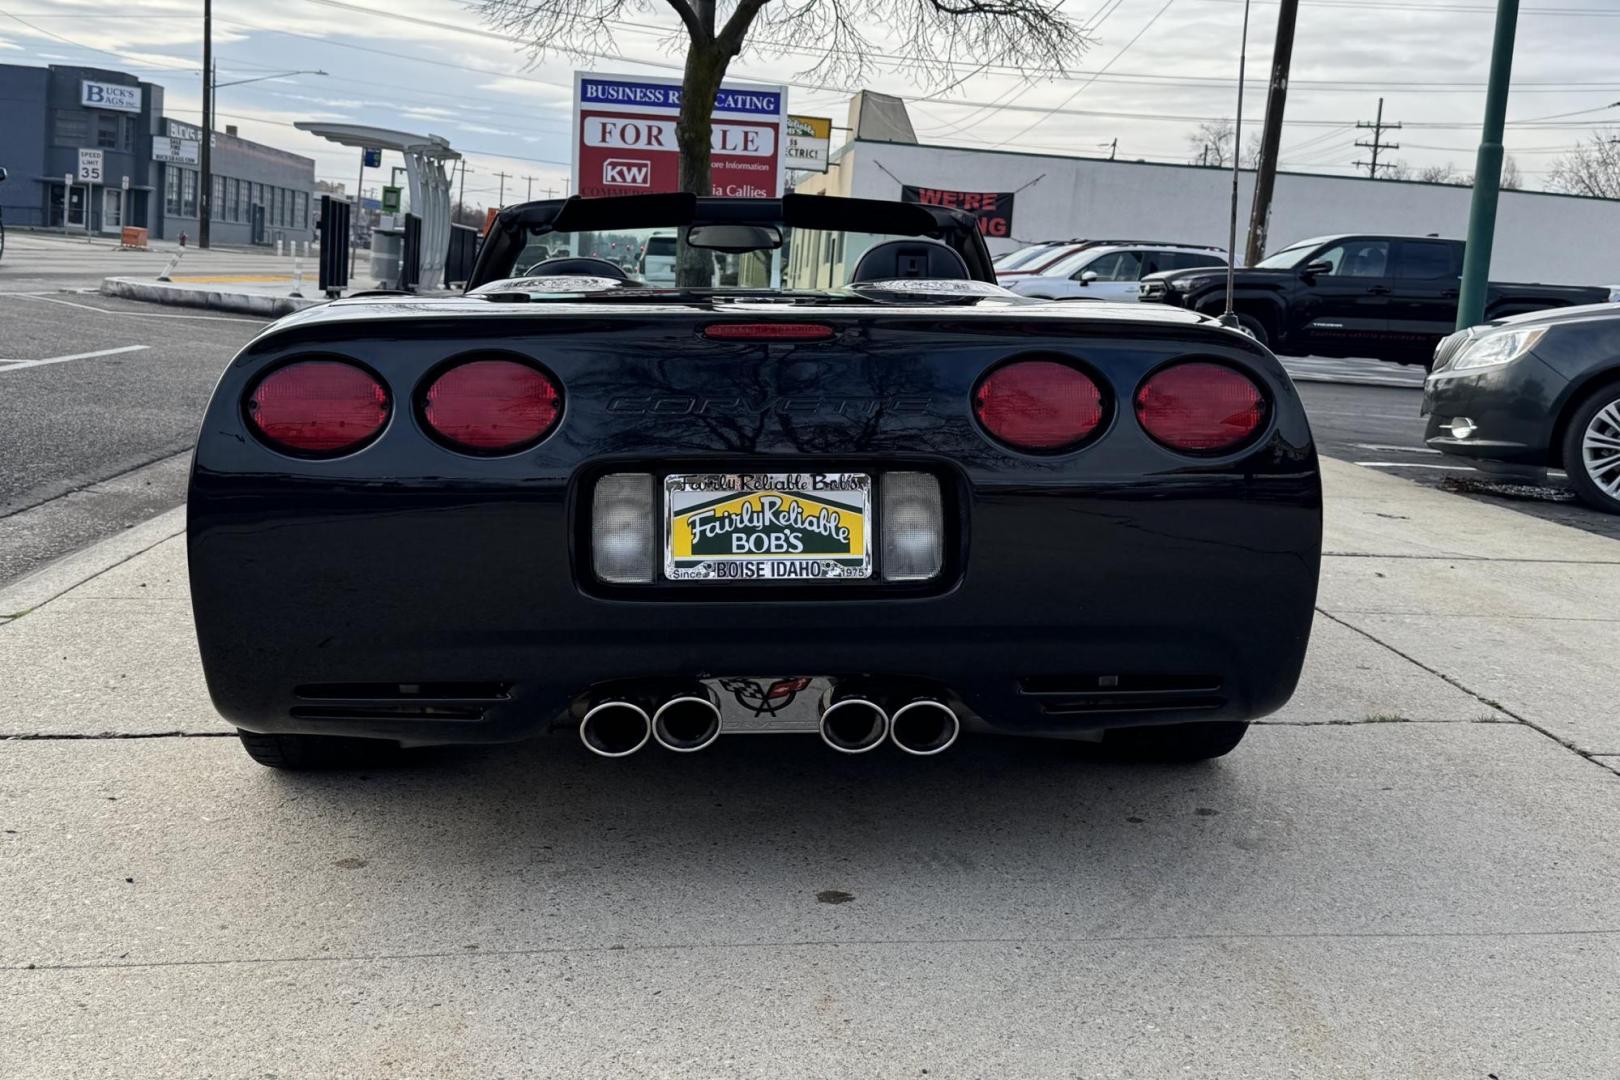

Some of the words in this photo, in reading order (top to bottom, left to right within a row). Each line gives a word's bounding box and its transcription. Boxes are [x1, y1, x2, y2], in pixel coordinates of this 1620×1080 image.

[585, 84, 664, 103] BUSINESS
[600, 121, 665, 147] FOR
[711, 128, 760, 152] LE
[81, 167, 100, 179] 35
[606, 165, 648, 184] KW
[726, 162, 769, 171] Information
[726, 184, 768, 198] Callies
[918, 188, 998, 211] WE'RE
[738, 474, 808, 492] Reliable
[687, 501, 764, 544] Fairly
[759, 495, 850, 544] Reliable
[731, 528, 804, 554] BOB'S
[673, 569, 703, 579] Since
[717, 561, 766, 578] BOISE
[770, 561, 821, 578] IDAHO
